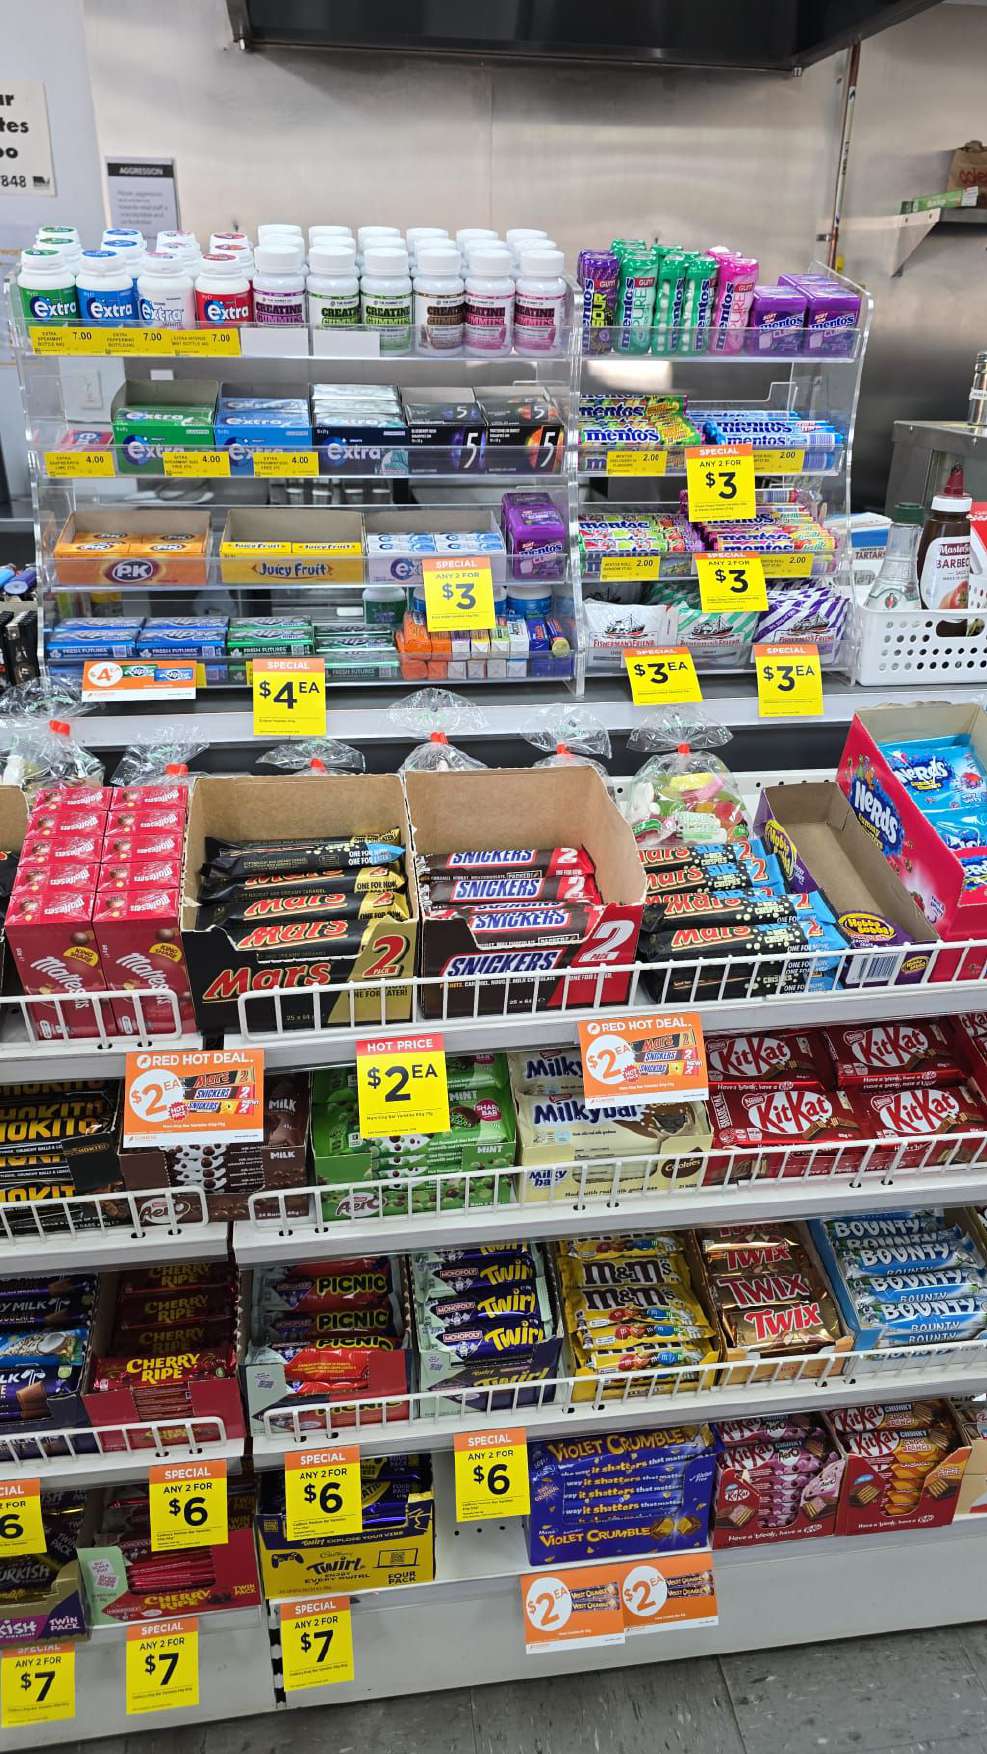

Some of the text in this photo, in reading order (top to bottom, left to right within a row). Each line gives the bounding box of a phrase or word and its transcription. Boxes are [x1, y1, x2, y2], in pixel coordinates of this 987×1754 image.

[34, 301, 77, 318] extra
[90, 301, 133, 318] extra
[142, 303, 184, 321] extra
[207, 303, 249, 320] extra
[72, 331, 92, 340] 7.00
[143, 332, 162, 341] 7.00
[213, 333, 231, 342] 7.00
[584, 427, 660, 443] mentos
[327, 442, 381, 460] extra
[540, 431, 556, 468] 5
[699, 447, 739, 456] SPECIAL
[86, 456, 104, 464] 4.00
[203, 455, 221, 463] 4.00
[292, 456, 309, 464] 4.00
[705, 471, 738, 500] $3
[259, 562, 327, 577] Juicy Fruit
[436, 560, 478, 569] SPECIAL
[714, 568, 750, 594] $3
[442, 582, 477, 610] $3
[266, 662, 311, 670] SPECIAL
[633, 661, 688, 684] $3 EA
[763, 665, 815, 692] $3 EA
[259, 680, 321, 710] $4 EA
[854, 780, 898, 844] Nerds
[452, 849, 533, 865] SNICKERS
[556, 847, 577, 864] 2
[739, 840, 752, 860] 2
[752, 859, 768, 882] 2
[357, 882, 370, 890] ONE
[455, 879, 541, 899] SNICKERS
[564, 877, 585, 899] 2
[807, 920, 824, 937] 2
[578, 919, 635, 962] 2
[363, 934, 407, 977] 2
[447, 951, 560, 977] SNICKERS
[203, 962, 332, 1000] Mars
[602, 1022, 626, 1032] RED
[628, 1020, 652, 1030] HOT
[367, 1038, 433, 1053] HOT PRICE
[858, 1024, 925, 1067] KitKat
[152, 1055, 179, 1066] RED
[182, 1053, 210, 1065] HOT
[587, 1049, 622, 1079] $2
[645, 1051, 677, 1061] SNICKERS
[718, 1037, 788, 1076] KitKat
[367, 1063, 438, 1103] $2 EA
[131, 1079, 181, 1116] $2 EA
[195, 1088, 230, 1099] SNICKERS
[449, 1091, 478, 1101] MINT
[757, 1091, 829, 1133] KitKat
[887, 1089, 955, 1132] KitKat
[270, 1151, 296, 1160] MILK
[833, 1218, 919, 1238] BOUNTY
[861, 1242, 949, 1267] BOUNTY
[317, 1274, 388, 1296] PICNIC
[869, 1269, 963, 1292] BOUNTY
[717, 1274, 810, 1309] TWIX
[145, 1294, 209, 1315] CHERRY
[880, 1297, 975, 1320] BOUNTY
[317, 1309, 389, 1331] PICNIC
[744, 1301, 824, 1342] TWIX
[911, 1321, 961, 1332] BOUNTY
[443, 1330, 482, 1342] MONOPOLY
[126, 1353, 201, 1375] CHERRY
[141, 1366, 184, 1385] RIPE
[467, 1435, 512, 1447] SPECIAL
[547, 1429, 686, 1462] VIOLET CRUMBLE
[300, 1452, 345, 1466] SPECIAL
[467, 1452, 487, 1461] ANY
[496, 1449, 514, 1458] FOR
[164, 1468, 211, 1480] SPECIAL
[299, 1468, 348, 1480] ANY 2 FOR
[472, 1463, 511, 1495] $6
[163, 1482, 212, 1494] ANY 2 FOR
[6, 1500, 26, 1508] FOR
[304, 1481, 344, 1514] $6
[169, 1496, 208, 1527] $6
[582, 1502, 639, 1515] it shatters
[539, 1527, 651, 1548] VIOLET CRUMBLE
[306, 1556, 362, 1575] Twirl
[388, 1571, 416, 1579] FOUR
[388, 1576, 417, 1585] PACK
[143, 1589, 210, 1606] CHERRY
[624, 1580, 656, 1612] $2
[295, 1602, 337, 1616] SPECIAL
[527, 1592, 559, 1626] $2
[50, 1616, 78, 1626] TWIN
[50, 1622, 80, 1632] PACK
[141, 1622, 184, 1635] SPECIAL
[294, 1616, 339, 1630] ANY 2 FOR
[139, 1637, 185, 1651] ANY 2 FOR
[300, 1629, 334, 1663] $7
[15, 1655, 62, 1668] ANY 2 FOR
[144, 1652, 179, 1687] $7
[20, 1671, 56, 1702] $7
